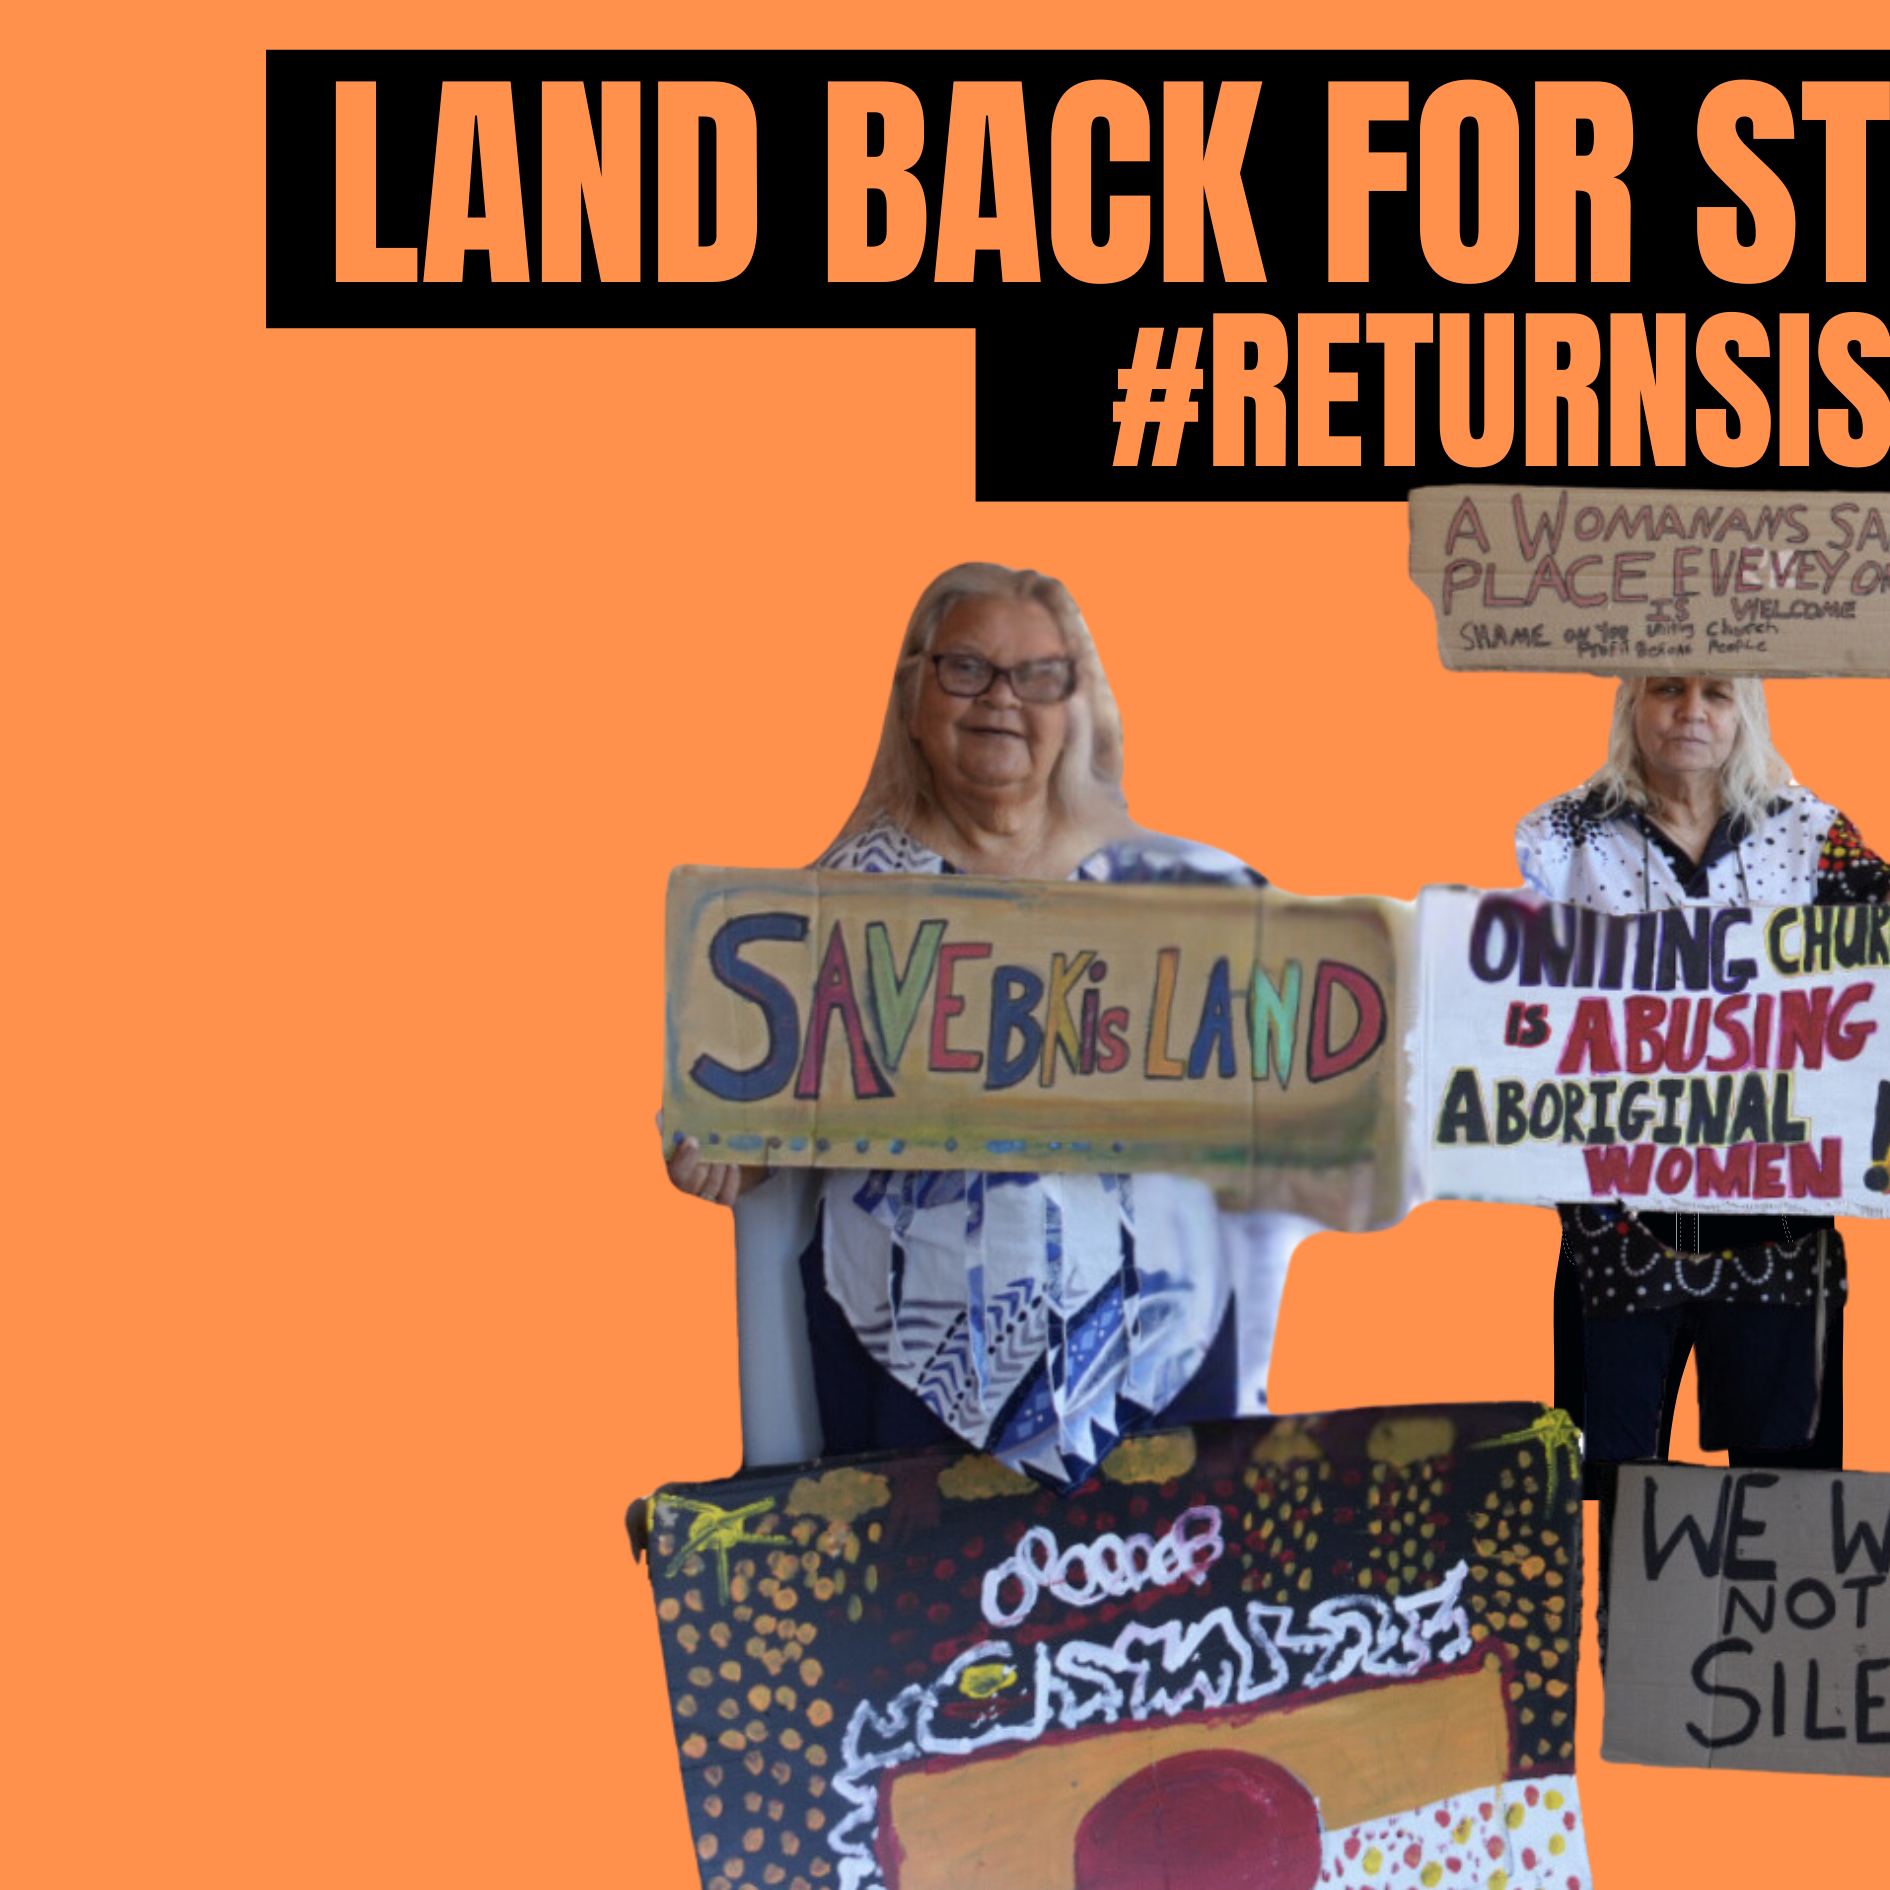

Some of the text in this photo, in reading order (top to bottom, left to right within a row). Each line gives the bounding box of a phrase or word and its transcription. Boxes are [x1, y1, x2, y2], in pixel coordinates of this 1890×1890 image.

[1444, 497, 1491, 555] A
[1442, 553, 1656, 616] PLACE
[1646, 598, 1856, 622] IS WELCOME
[1460, 621, 1551, 650] SHAME
[689, 912, 993, 1101] SAVE
[1144, 946, 1388, 1090] LAND
[1504, 981, 1878, 1075] IS ABUSING
[1433, 1066, 1812, 1146] ABORIGINAL
[1582, 1137, 1843, 1199] WOMEN
[1644, 1473, 1780, 1580] WE
[1722, 1575, 1887, 1635] NOT
